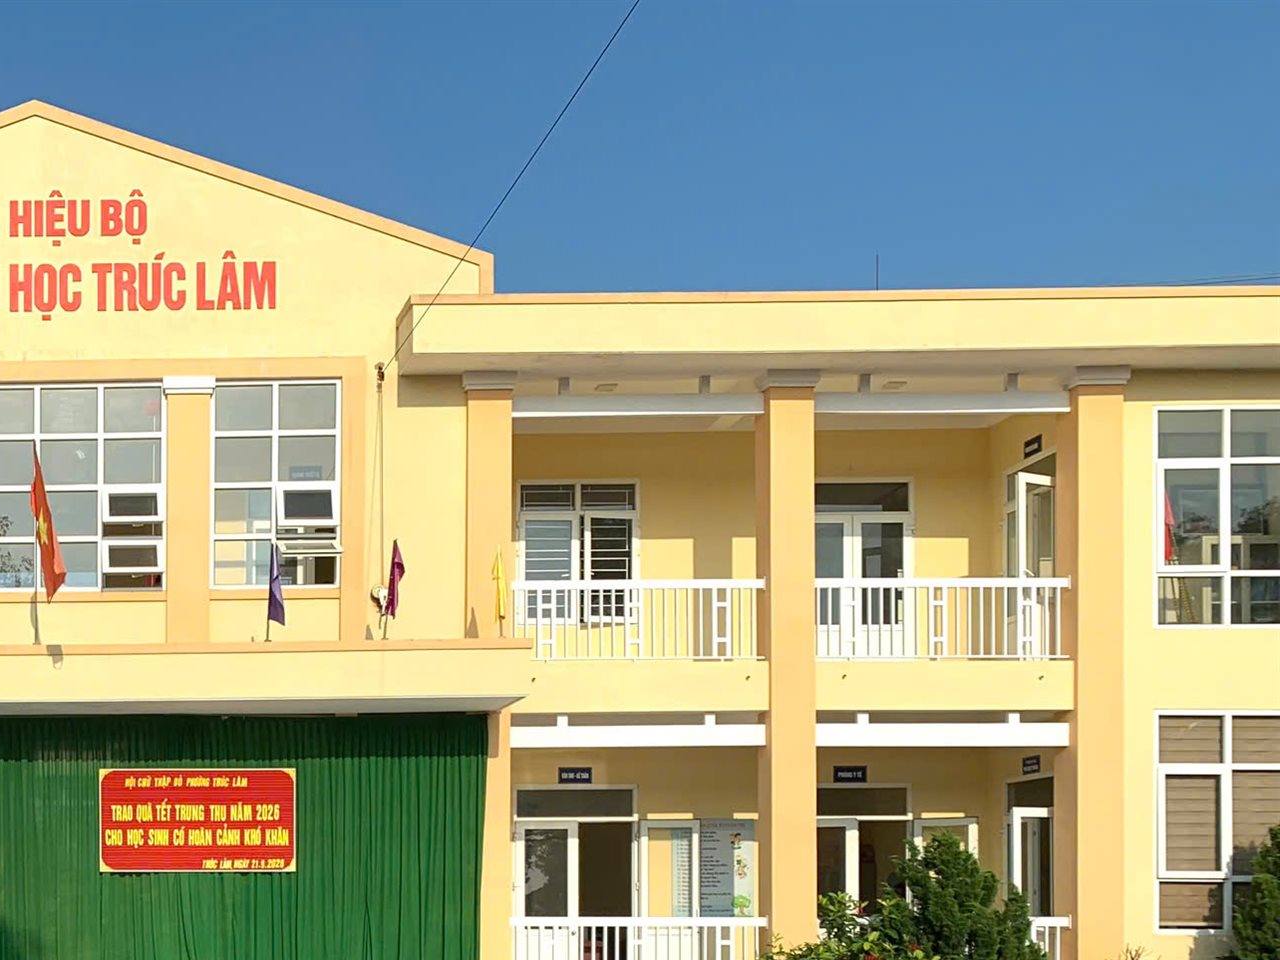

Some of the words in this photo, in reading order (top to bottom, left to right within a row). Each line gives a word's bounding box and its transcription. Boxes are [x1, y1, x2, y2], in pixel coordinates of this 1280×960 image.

[9, 189, 91, 247] HIỆU
[100, 188, 148, 245] BỘ
[9, 262, 81, 321] HỌC
[92, 251, 187, 312] TRÚC
[196, 250, 277, 311] LÂM
[111, 804, 133, 821] TRAO
[136, 802, 153, 823] QUÀ
[156, 798, 172, 822] TẾT
[175, 804, 205, 821] TRUNG
[210, 804, 227, 821] THU
[230, 801, 252, 821] NĂM
[105, 829, 123, 846] CHO
[127, 829, 144, 848] HỌC
[148, 829, 169, 846] SINH
[173, 826, 185, 846] CÓ
[188, 827, 212, 846] HOÀN
[216, 823, 240, 846] CẢNH
[244, 826, 261, 846] KHÓ
[265, 826, 289, 846] KHĂN
